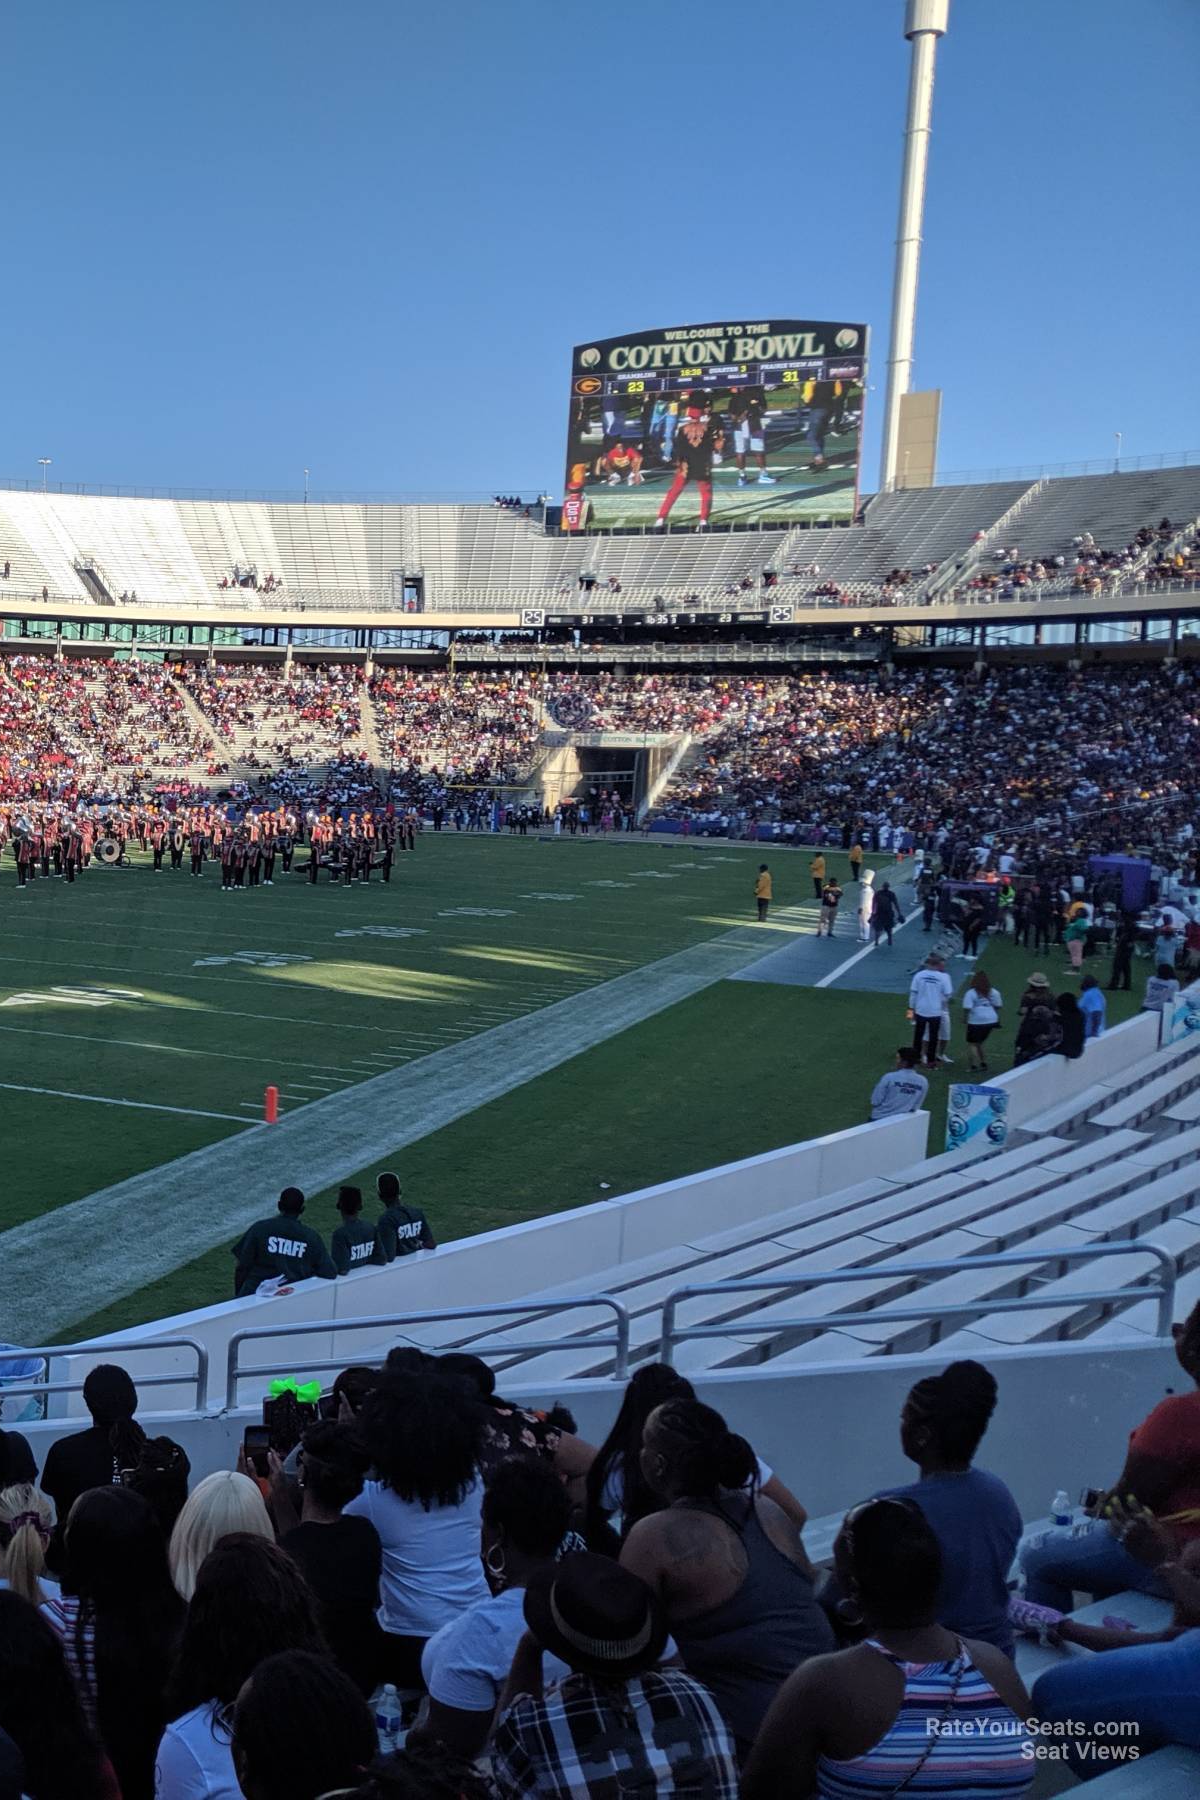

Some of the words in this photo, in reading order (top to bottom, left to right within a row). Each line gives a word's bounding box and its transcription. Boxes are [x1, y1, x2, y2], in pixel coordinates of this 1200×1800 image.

[664, 327, 723, 341] WELCOME
[727, 326, 743, 336] TO
[745, 324, 770, 335] THE
[609, 340, 730, 370] COTTON
[732, 333, 824, 361] BOWL
[782, 370, 799, 382] 31
[628, 381, 644, 392] 23
[525, 611, 541, 624] 25
[582, 615, 594, 624] 31
[720, 614, 732, 622] 23
[773, 608, 790, 620] 25
[398, 1220, 422, 1240] STAFF
[268, 1236, 307, 1258] STAFF
[351, 1241, 375, 1261] STAFF
